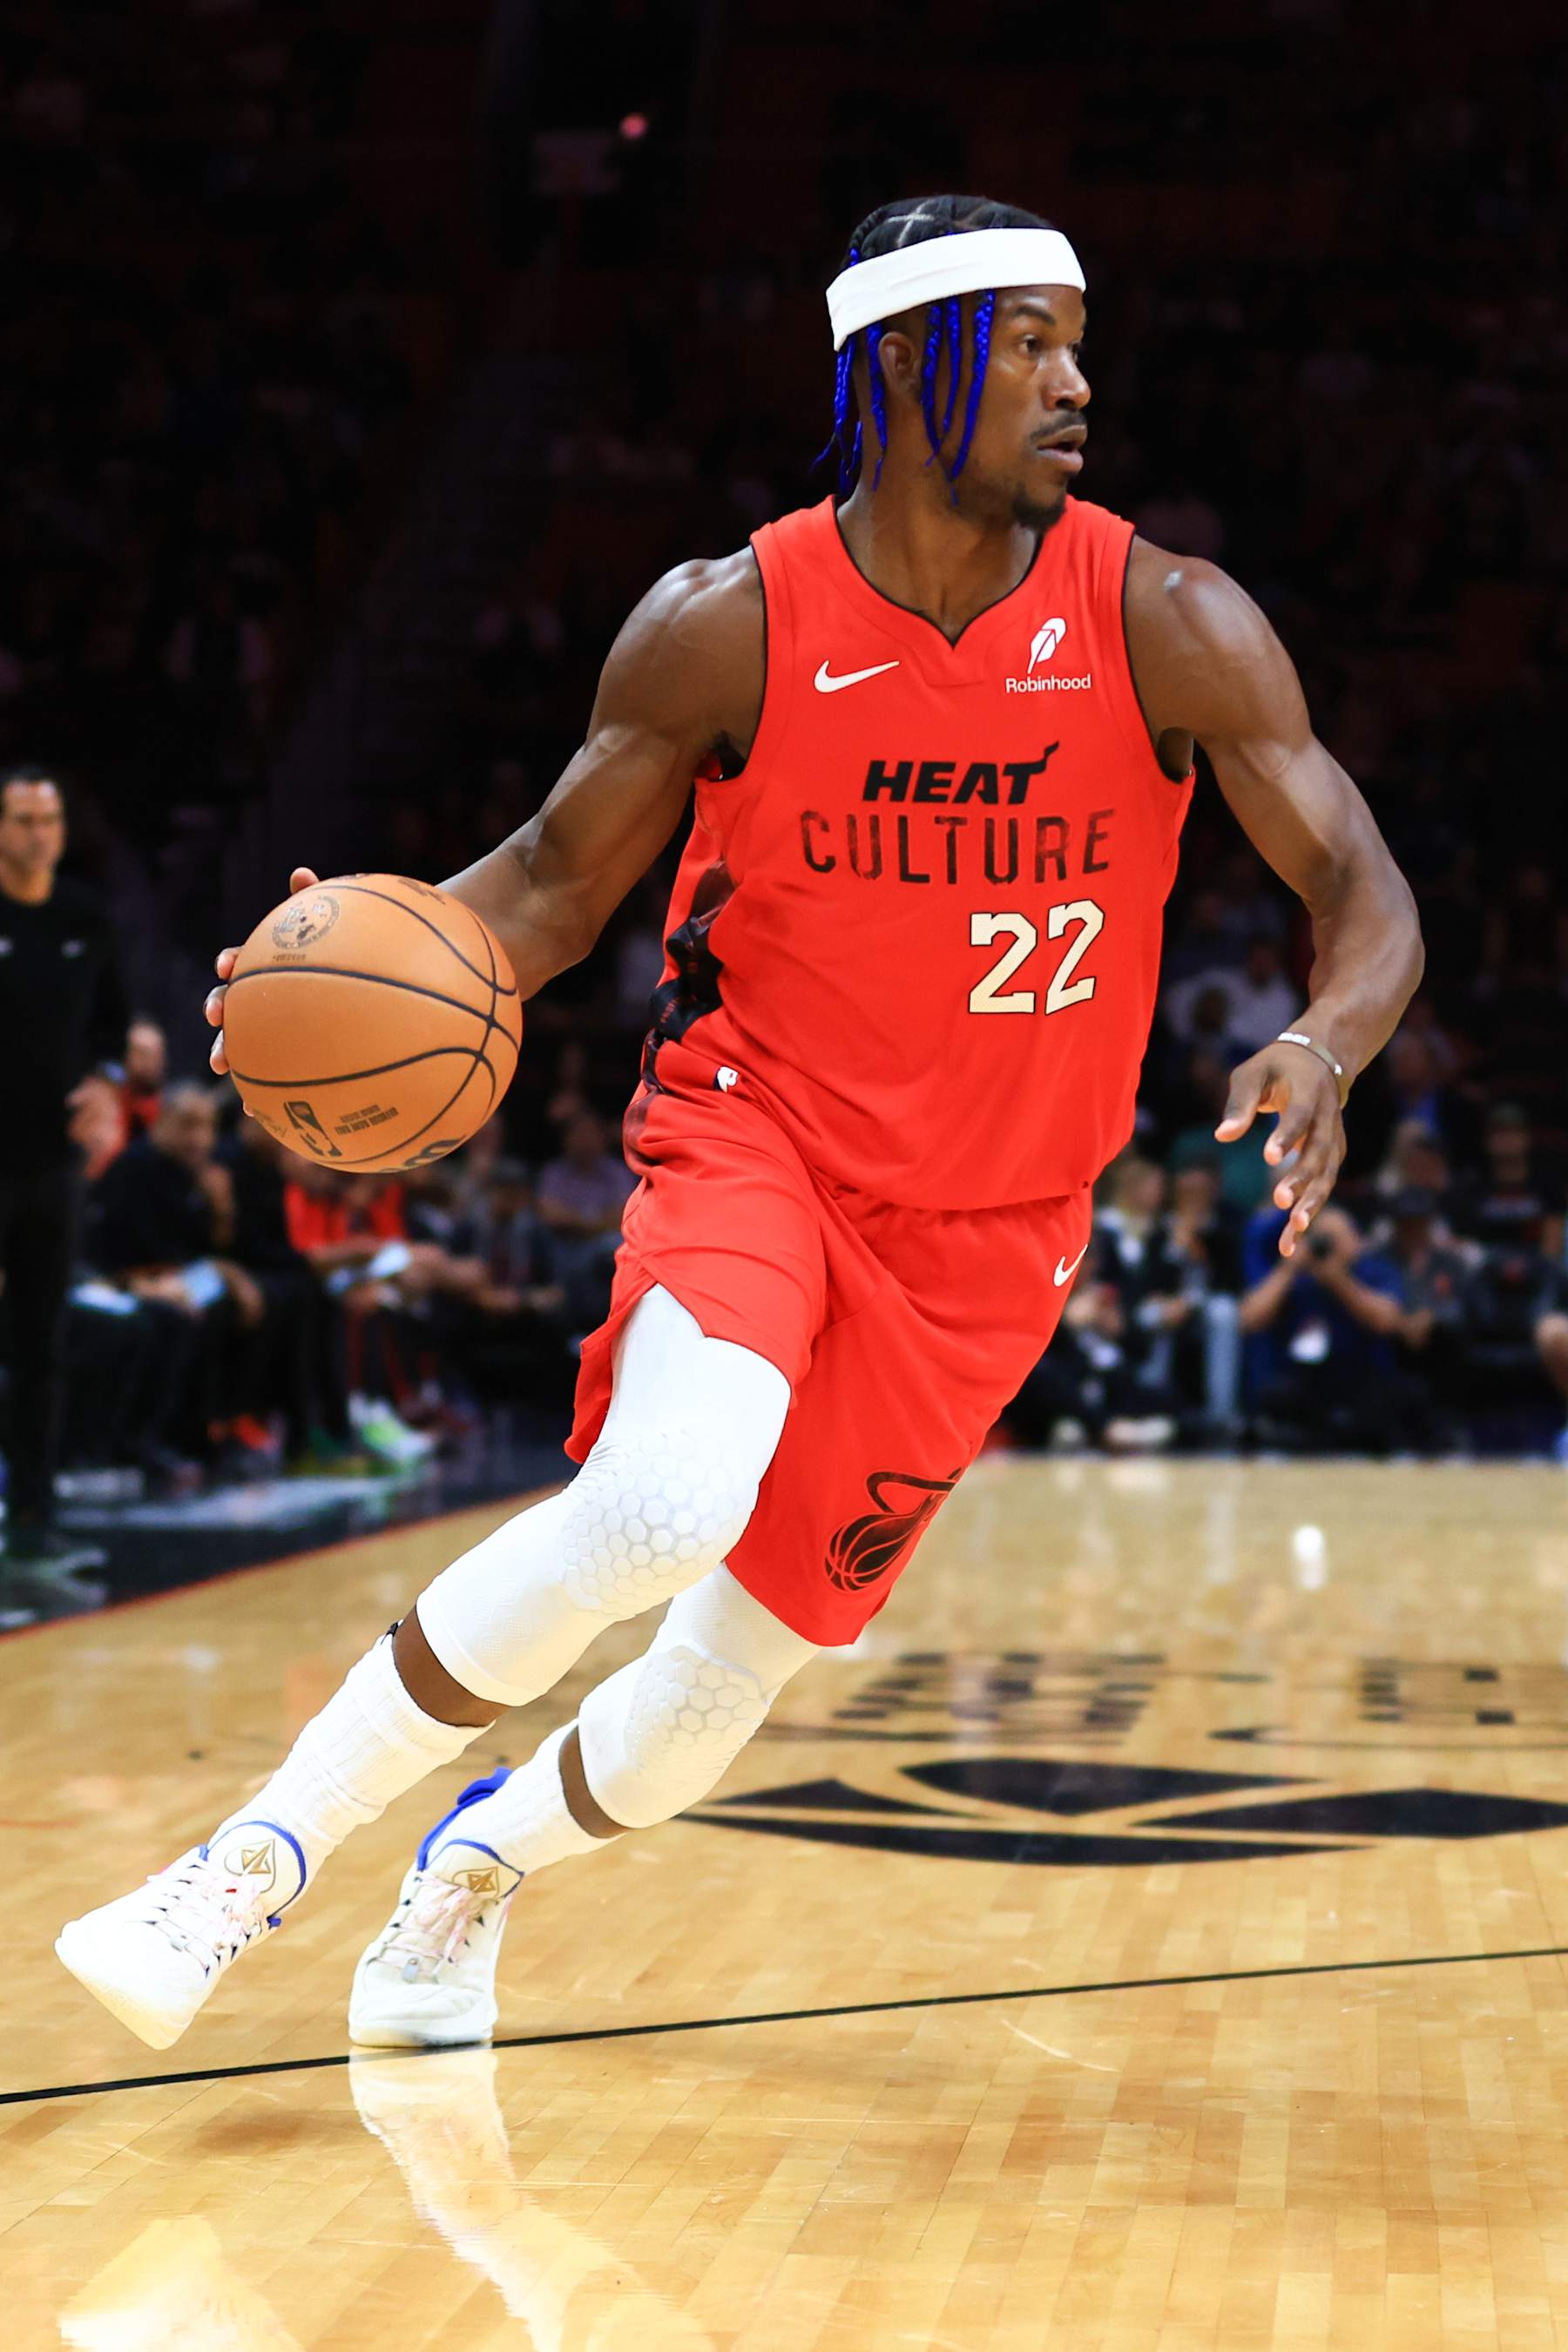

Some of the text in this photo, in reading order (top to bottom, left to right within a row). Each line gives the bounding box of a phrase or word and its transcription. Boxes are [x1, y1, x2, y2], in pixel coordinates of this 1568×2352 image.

[1004, 673, 1092, 694] Robinhood
[861, 740, 1060, 805] HEAT
[800, 808, 1116, 886] CULTURE
[968, 898, 1105, 1017] 22
